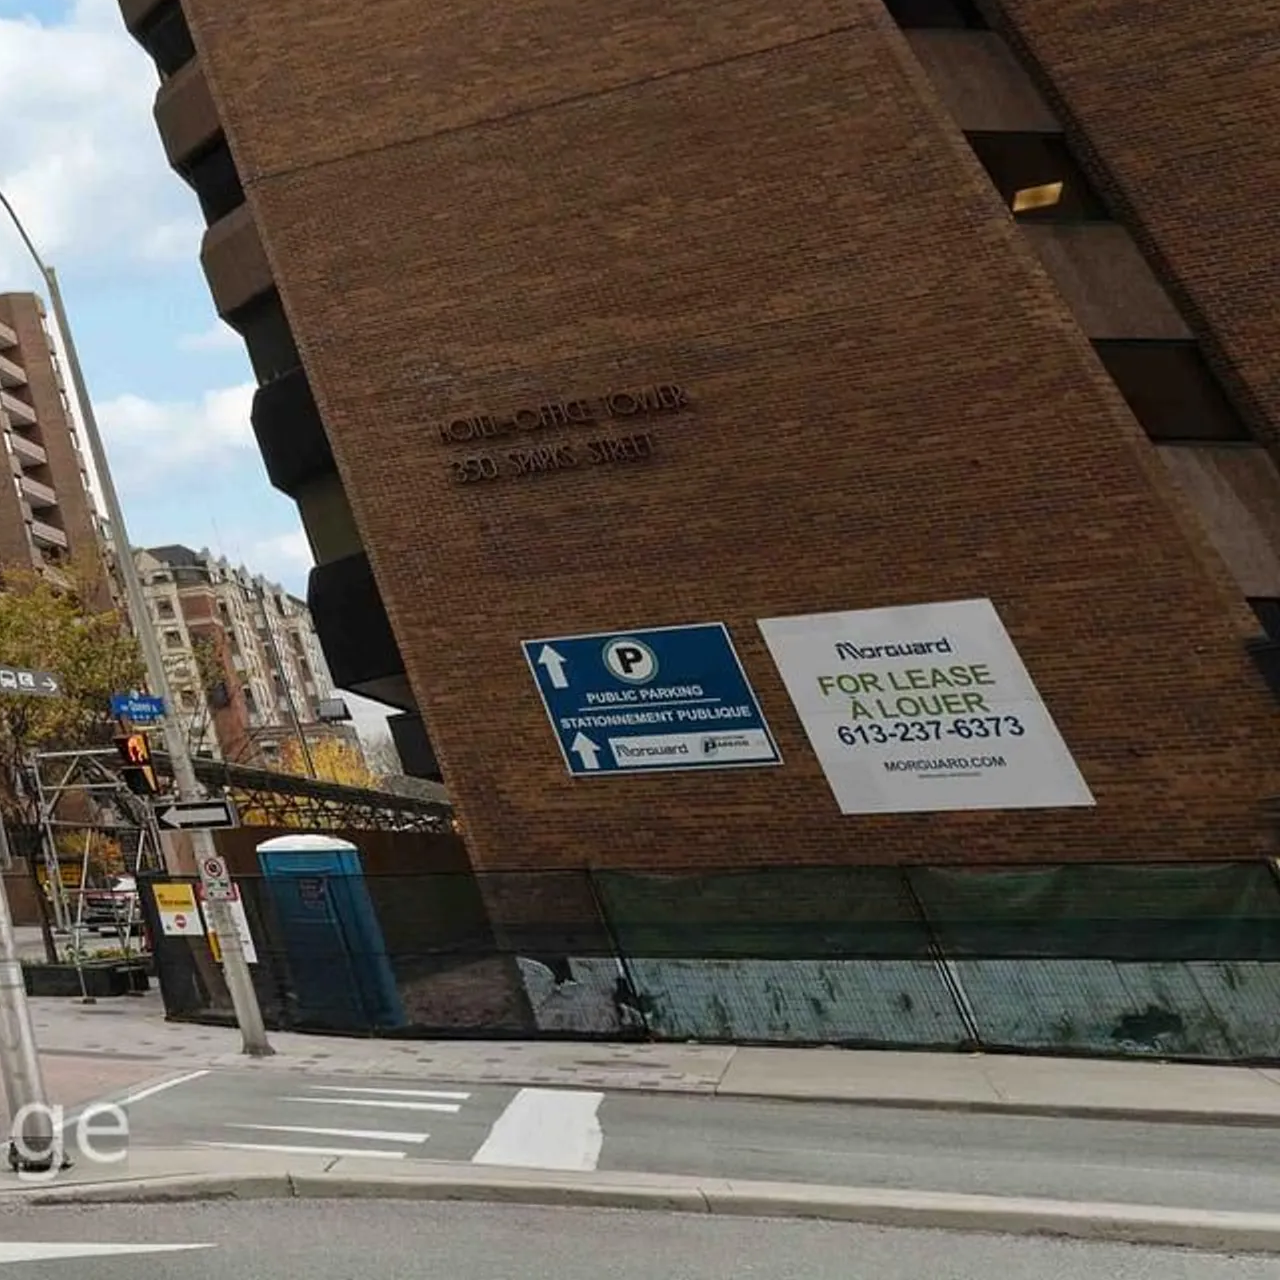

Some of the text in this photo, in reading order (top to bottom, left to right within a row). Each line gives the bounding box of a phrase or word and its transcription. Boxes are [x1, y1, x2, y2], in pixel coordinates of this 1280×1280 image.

[451, 432, 655, 484] 350 SPARKS STREET
[615, 647, 643, 674] P
[835, 637, 953, 661] Morguard
[817, 663, 996, 697] FOR LEASE
[586, 684, 704, 705] PUBLIC PARKING
[849, 691, 991, 721] À LOUER
[560, 705, 752, 730] STATIONNEMENT PUBLIQUE
[837, 715, 1026, 747] 613-237-6373
[616, 742, 690, 758] Morguard
[883, 755, 1007, 773] MORGUARD.COM
